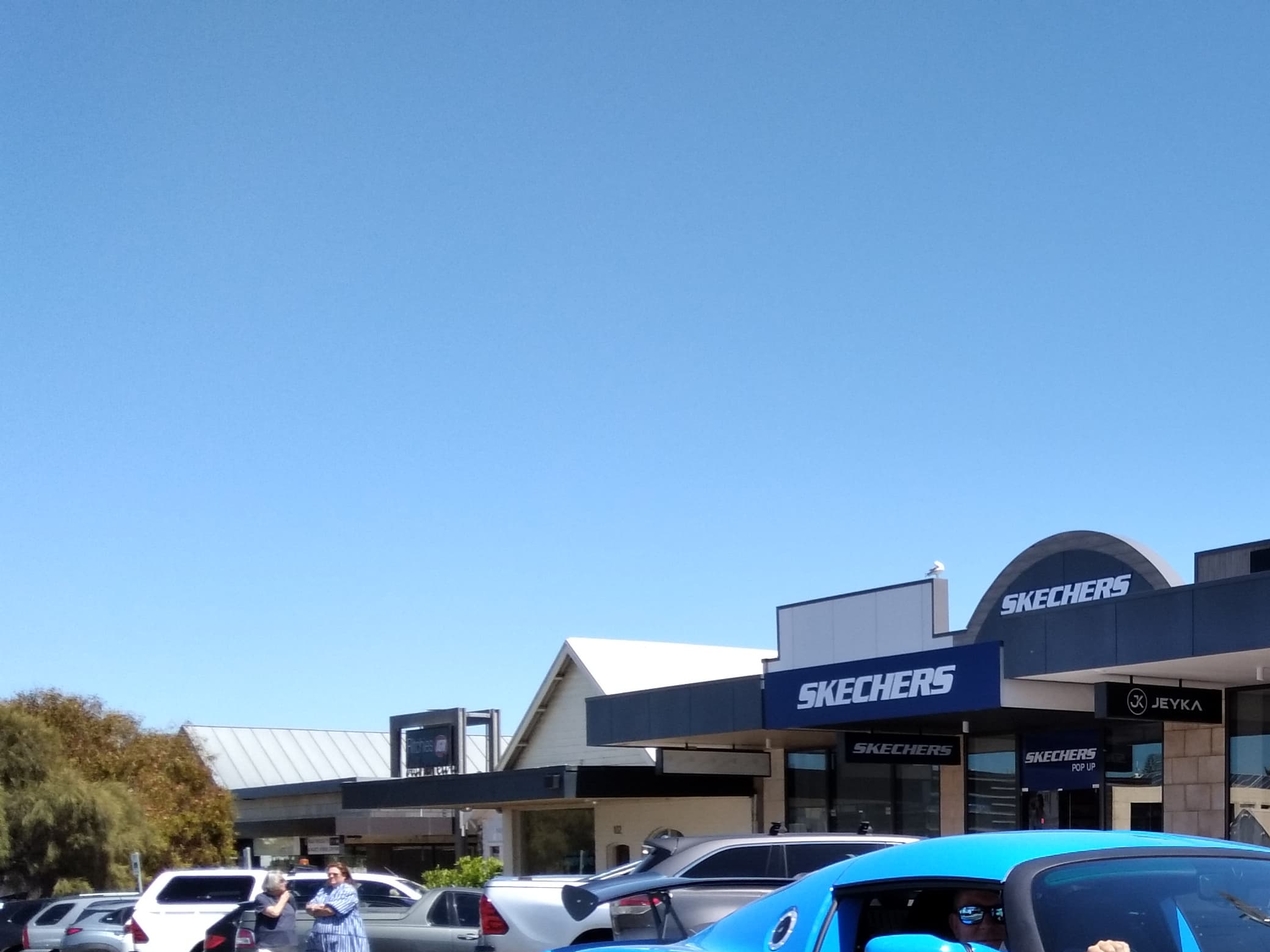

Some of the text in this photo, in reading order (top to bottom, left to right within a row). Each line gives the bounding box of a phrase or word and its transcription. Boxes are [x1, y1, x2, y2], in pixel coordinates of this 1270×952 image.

[1000, 573, 1132, 616] SKECHERS
[796, 664, 957, 710] SKECHERS
[1151, 697, 1203, 712] JEYKA
[852, 742, 954, 756] SKECHERS
[1024, 747, 1098, 764] SKECHERS
[1071, 762, 1096, 772] POP UP
